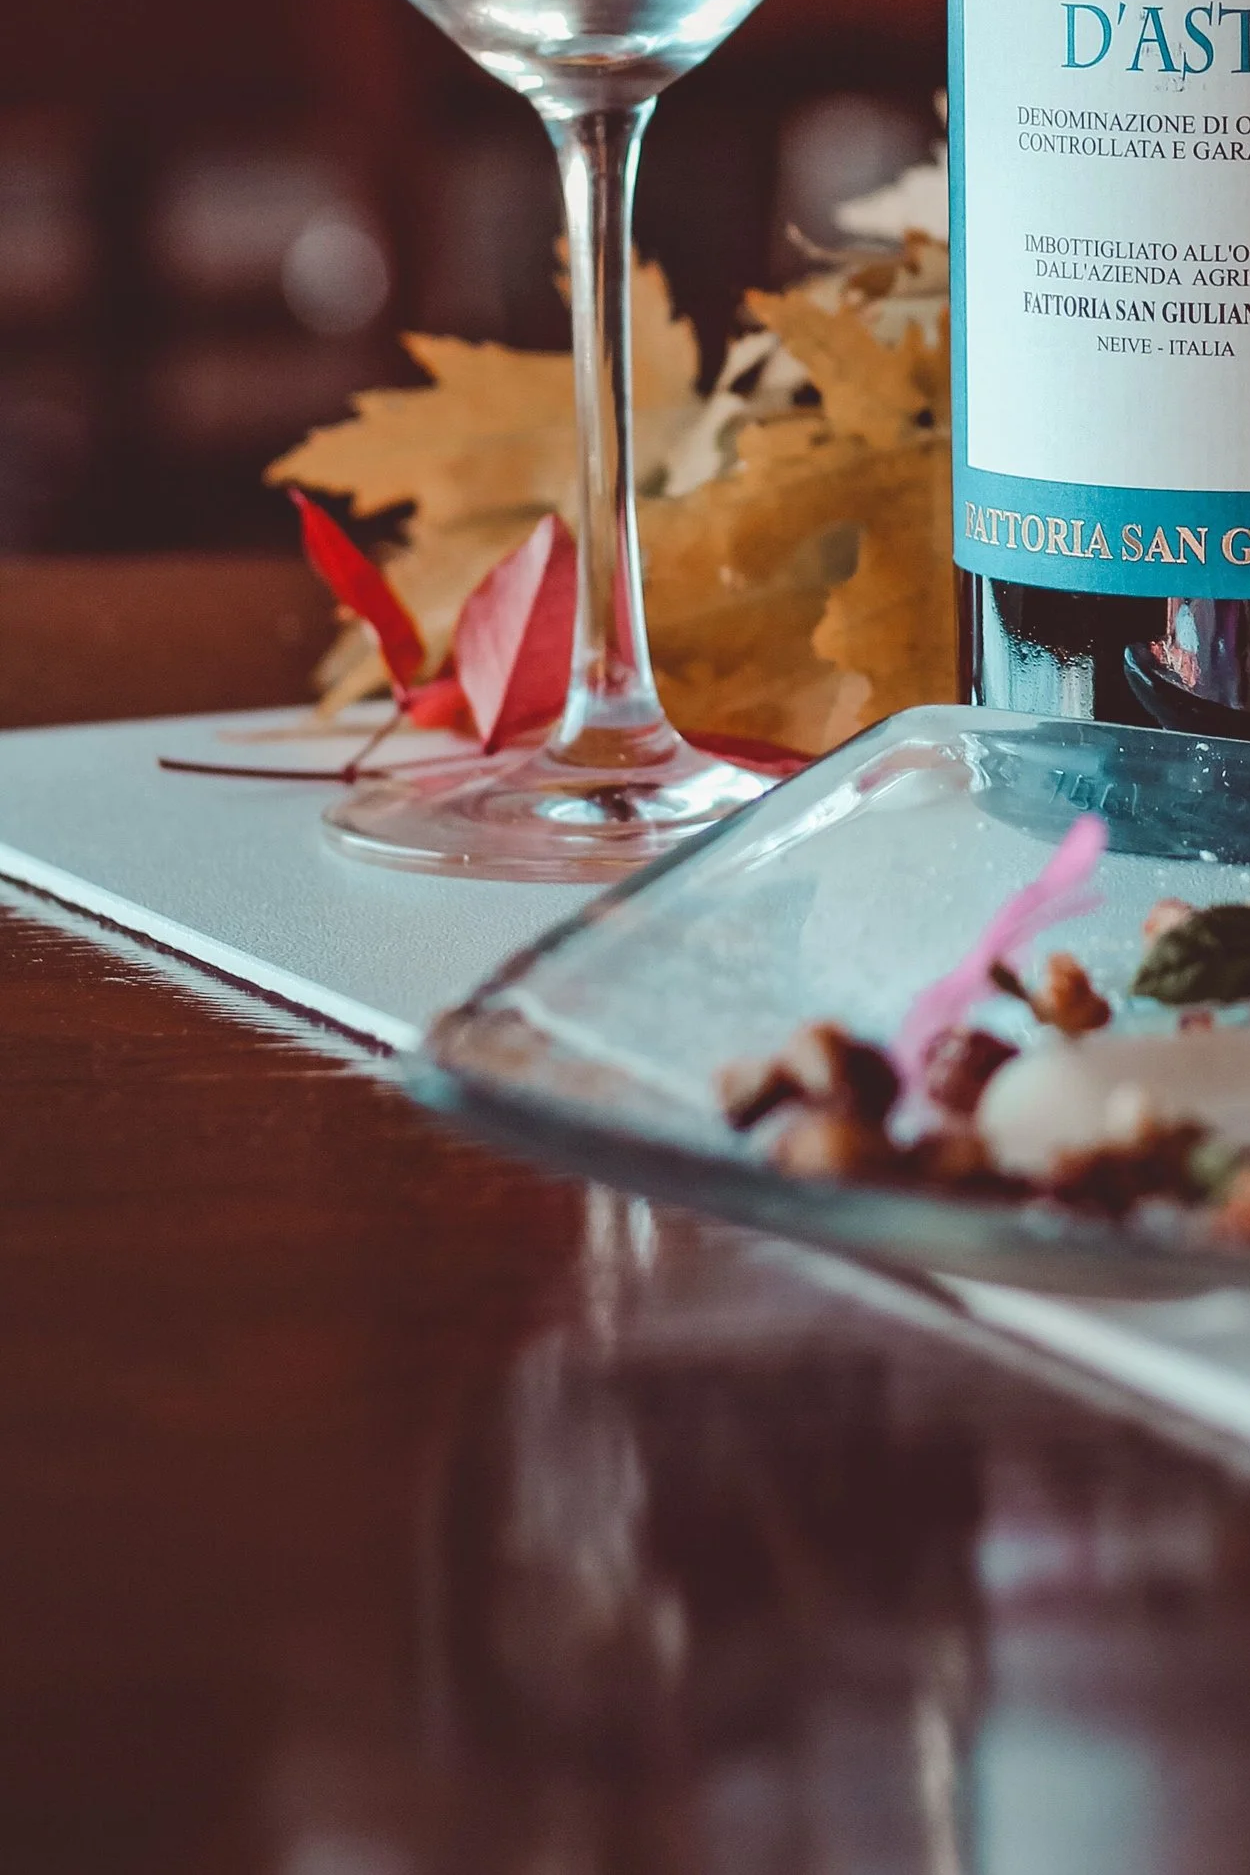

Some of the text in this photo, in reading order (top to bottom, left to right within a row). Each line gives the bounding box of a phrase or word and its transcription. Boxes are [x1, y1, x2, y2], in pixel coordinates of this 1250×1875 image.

[1017, 105, 1196, 135] DENOMINAZIONE
[1202, 114, 1230, 135] DI
[1018, 132, 1166, 159] CONTROLLATA
[1172, 141, 1186, 160] E
[1023, 234, 1178, 262] IMBOTTIGLIATO
[1034, 258, 1182, 286] DALL'AZIENDA
[1022, 290, 1111, 320] FATTORIA
[1115, 300, 1156, 323] SAN
[1096, 335, 1153, 355] NEIVE
[1169, 338, 1236, 357] ITALIA
[964, 500, 1112, 561] FATTORIA
[1120, 522, 1208, 566] SAN
